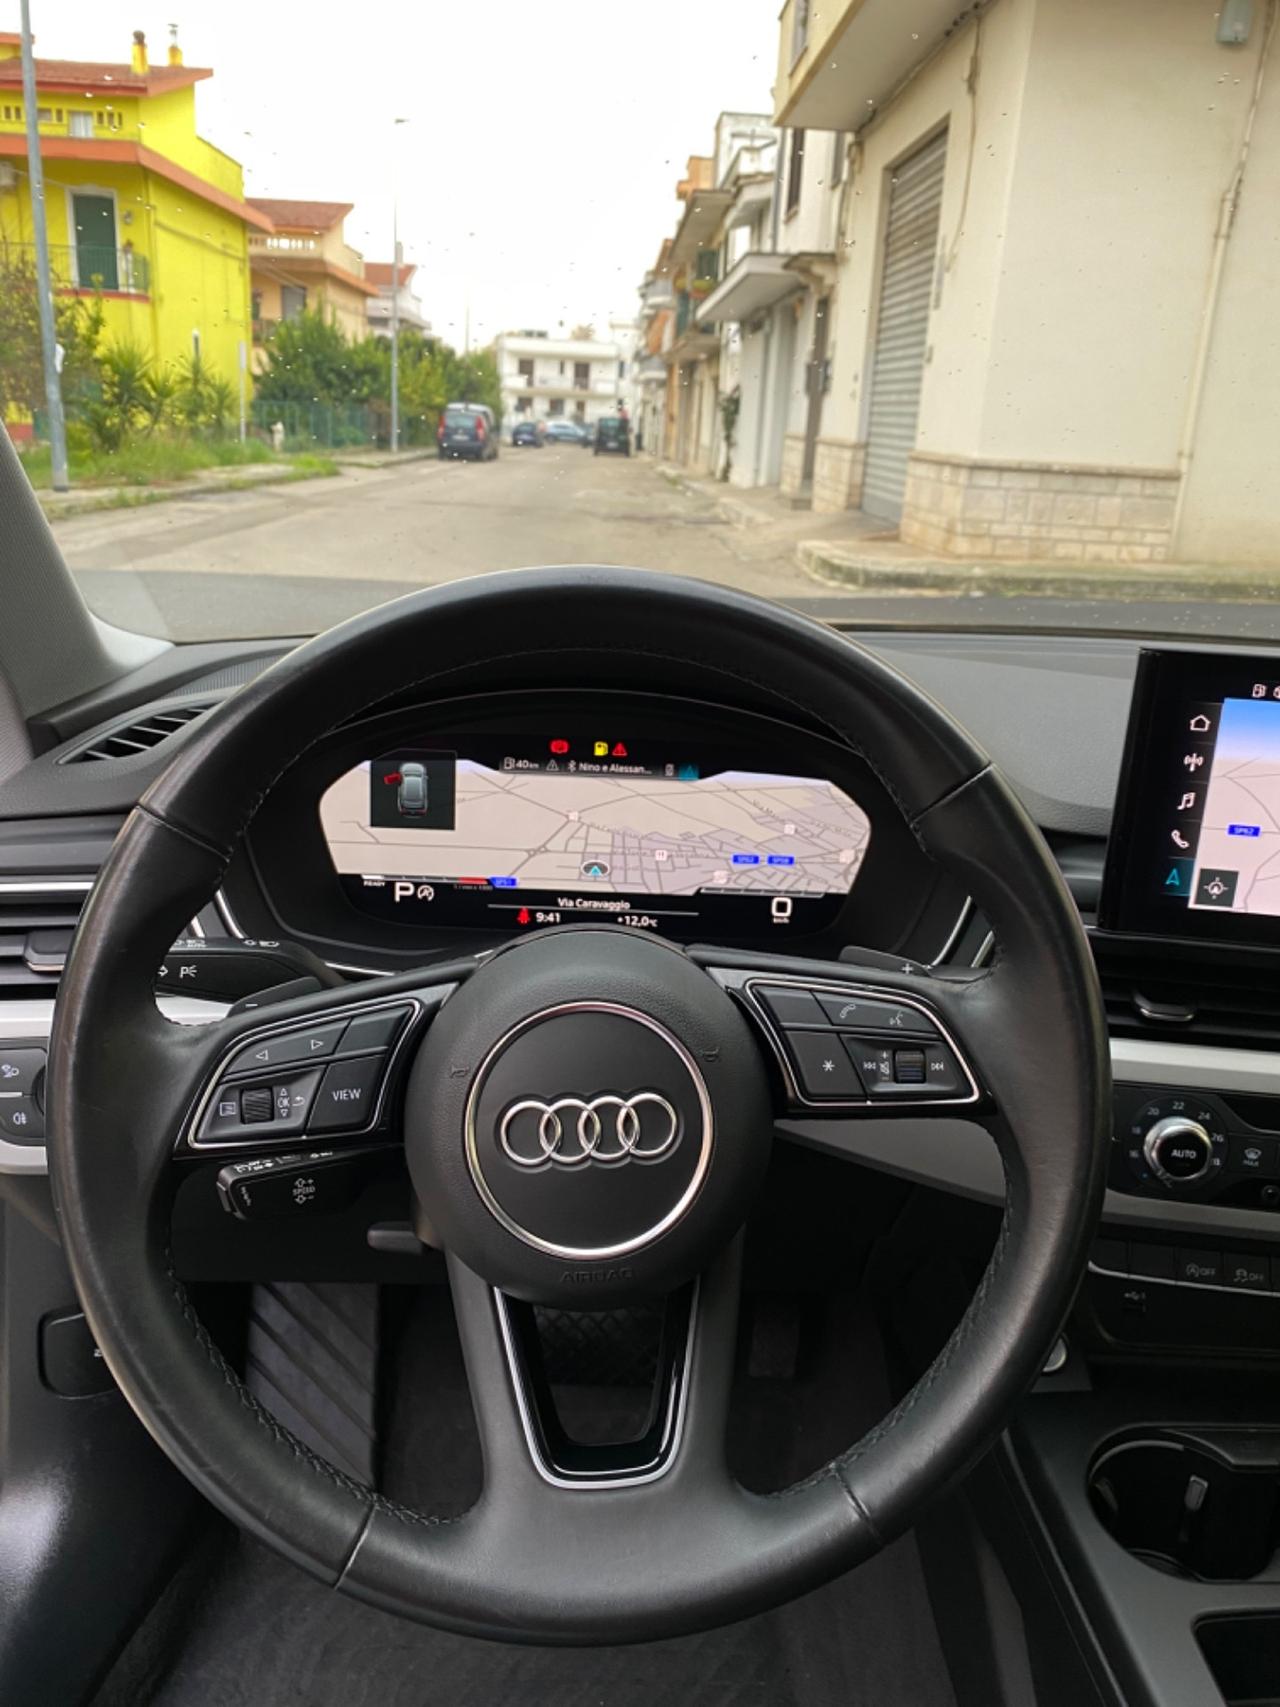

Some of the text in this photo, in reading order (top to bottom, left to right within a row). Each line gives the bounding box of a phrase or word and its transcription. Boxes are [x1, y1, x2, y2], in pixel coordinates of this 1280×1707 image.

[579, 763, 600, 772] Nino
[394, 882, 415, 902] P
[557, 898, 631, 911] Via Caravaggio
[771, 897, 793, 917] 0
[535, 912, 561, 923] 9:41
[332, 1088, 362, 1101] VIEW
[278, 1097, 290, 1108] OK
[1172, 1101, 1185, 1110] 22
[1198, 1111, 1211, 1120] 24
[1171, 1149, 1197, 1160] AUTO
[1200, 1267, 1216, 1276] OFF
